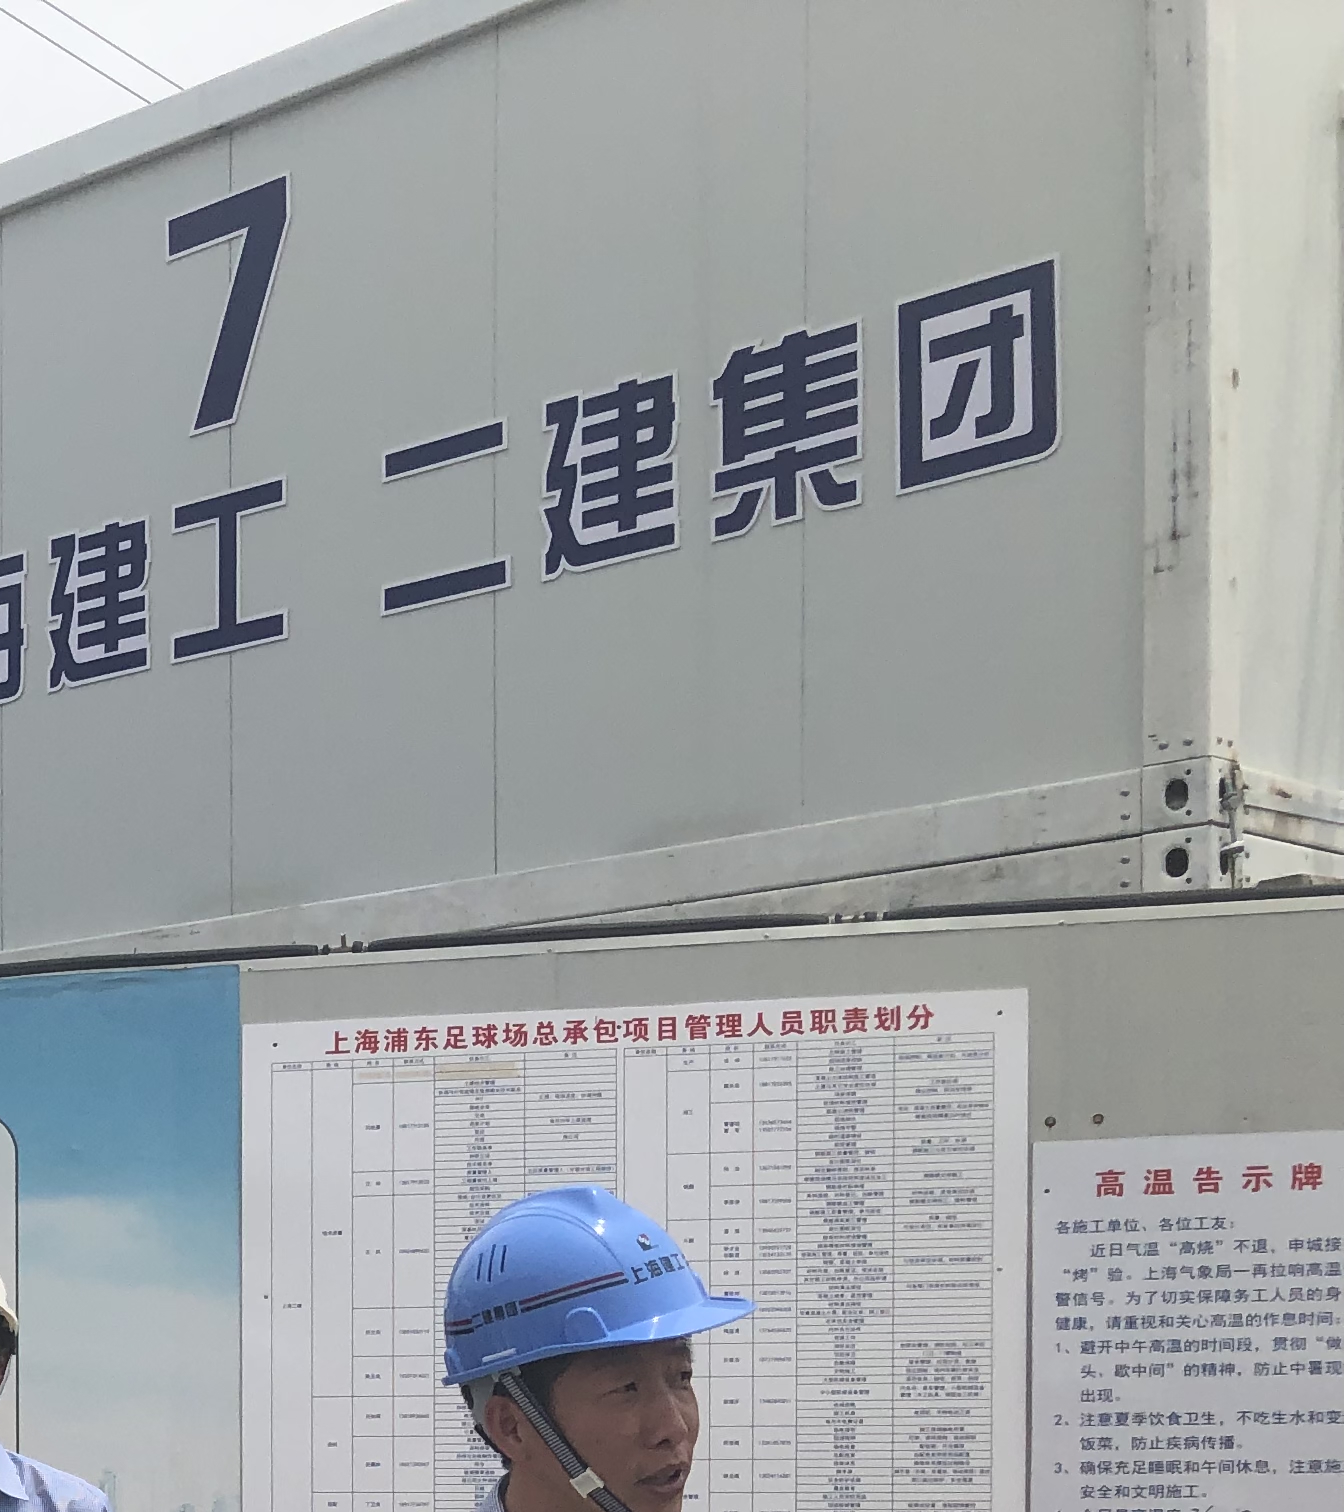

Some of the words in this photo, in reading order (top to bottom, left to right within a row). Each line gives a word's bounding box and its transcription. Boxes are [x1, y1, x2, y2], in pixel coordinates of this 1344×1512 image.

[168, 176, 290, 434] 7
[382, 258, 1059, 612] 二建集团
[325, 1004, 934, 1055] 上海浦东足球场总承包项目管理人员职责划分
[1095, 1162, 1324, 1198] 高温告示牌
[1055, 1216, 1235, 1236] 各施工单位、各位工友：
[1080, 1389, 1121, 1403] 出现。
[1054, 1410, 1344, 1428] 2、注意夏季饮食卫生，不吃生水和变
[1080, 1435, 1244, 1451] 饭菜，防止疾病传播。
[1080, 1484, 1209, 1500] 安全和文明施工。
